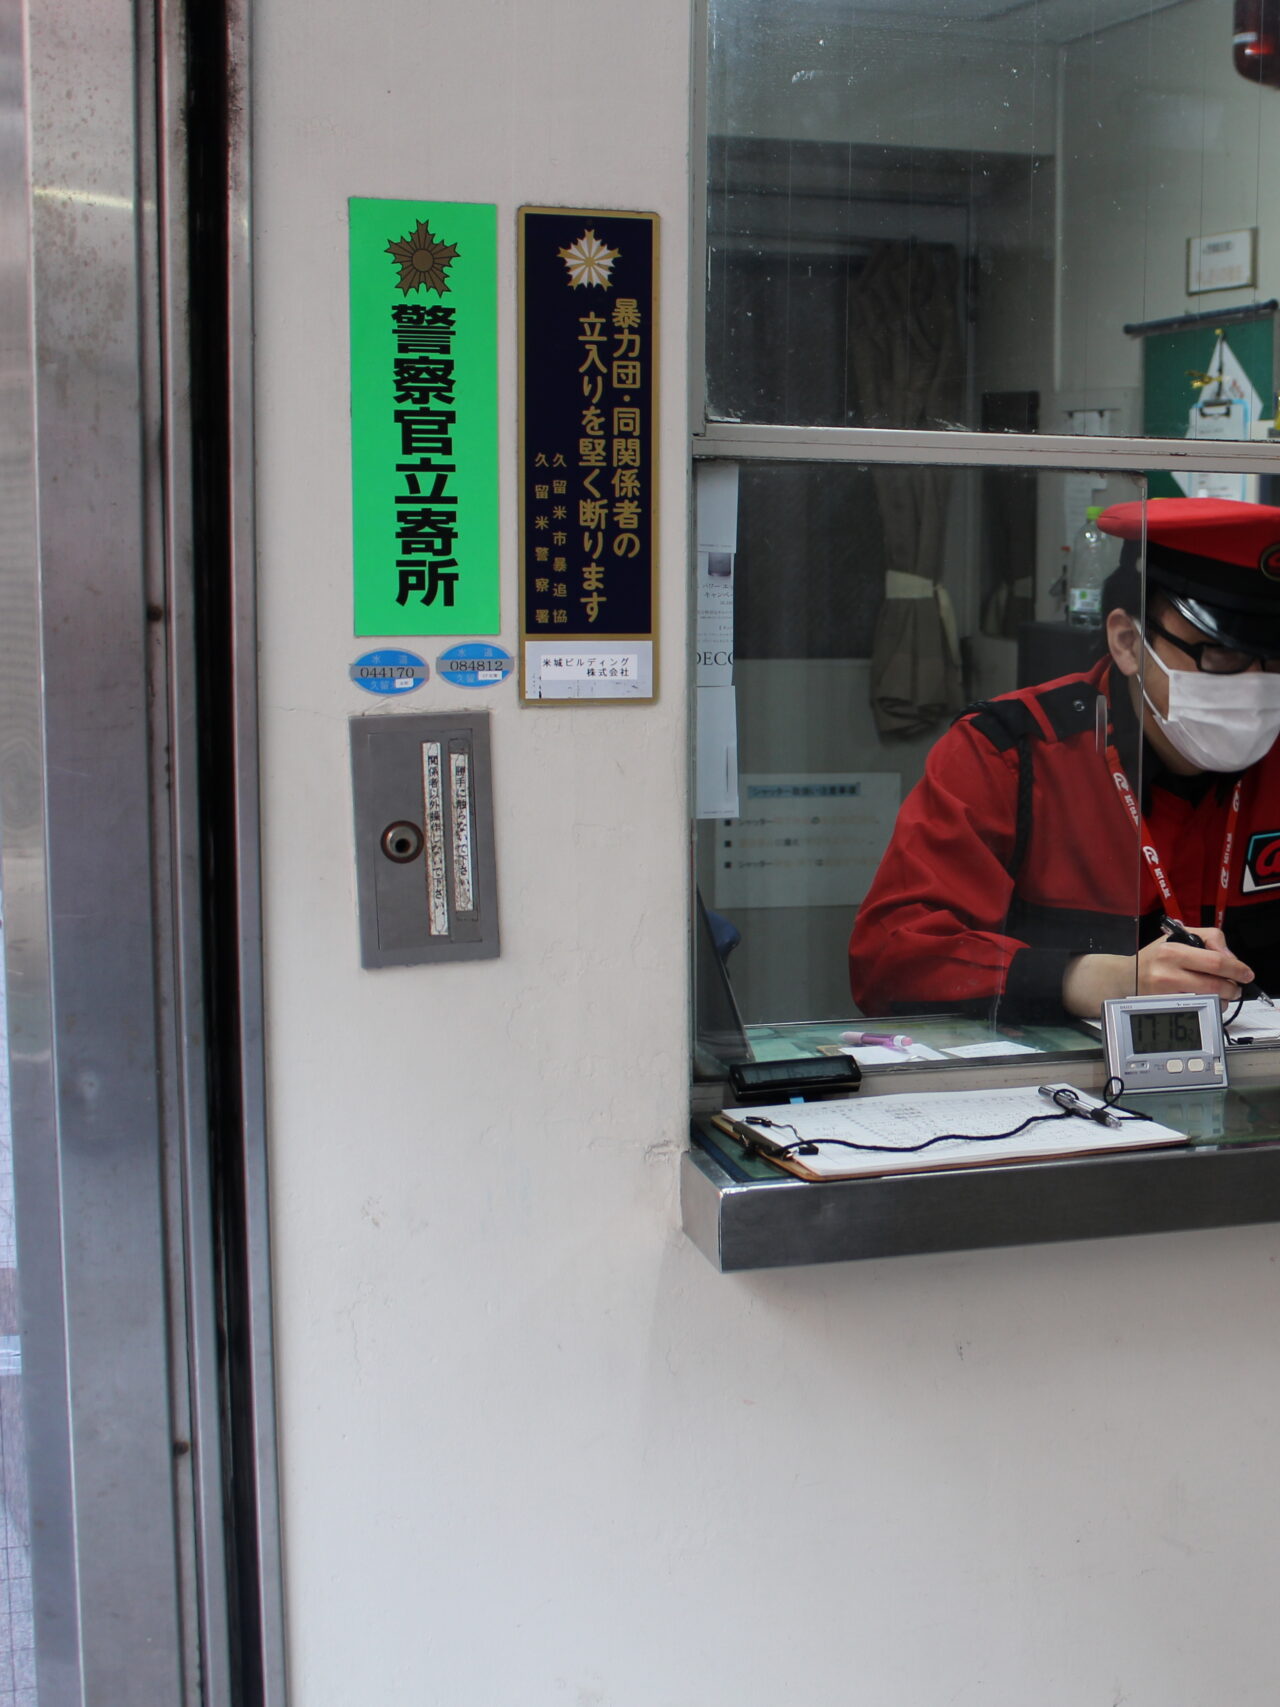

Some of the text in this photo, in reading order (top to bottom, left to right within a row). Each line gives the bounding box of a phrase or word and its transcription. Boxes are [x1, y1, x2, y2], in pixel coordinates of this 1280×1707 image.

[391, 303, 460, 608] 警察官立寄所
[578, 311, 608, 623] 立入りを堅く断ります
[612, 298, 642, 559] 暴力団・同関係者の
[534, 452, 550, 624] 久留米警察署
[552, 453, 568, 624] 久留米市暴追協
[360, 667, 415, 678] 044170
[450, 660, 503, 671] 084812
[542, 657, 630, 667] 米城ビルディング
[586, 667, 630, 677] 株式会社
